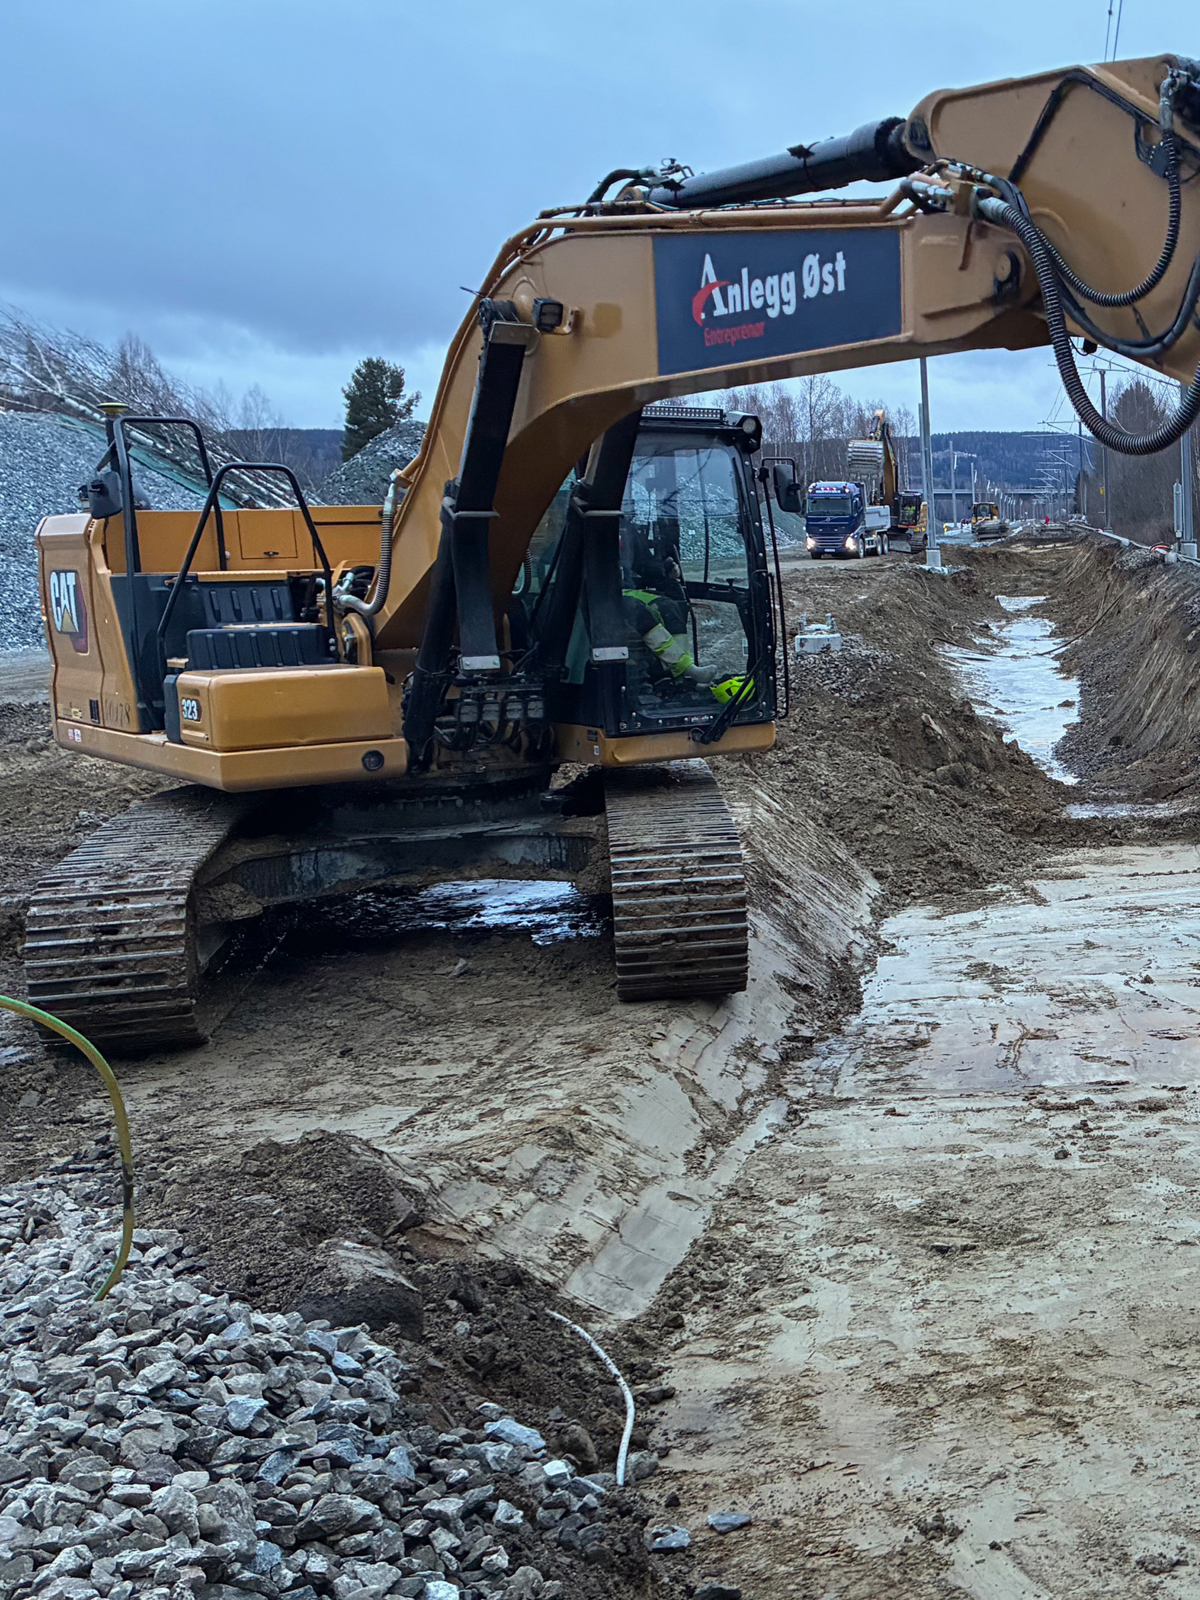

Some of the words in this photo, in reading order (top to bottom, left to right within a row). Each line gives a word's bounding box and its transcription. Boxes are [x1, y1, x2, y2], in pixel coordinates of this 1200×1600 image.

[700, 253, 797, 319] Anlegg
[802, 251, 846, 299] Øst
[50, 571, 79, 633] CAT
[181, 698, 198, 721] 323
